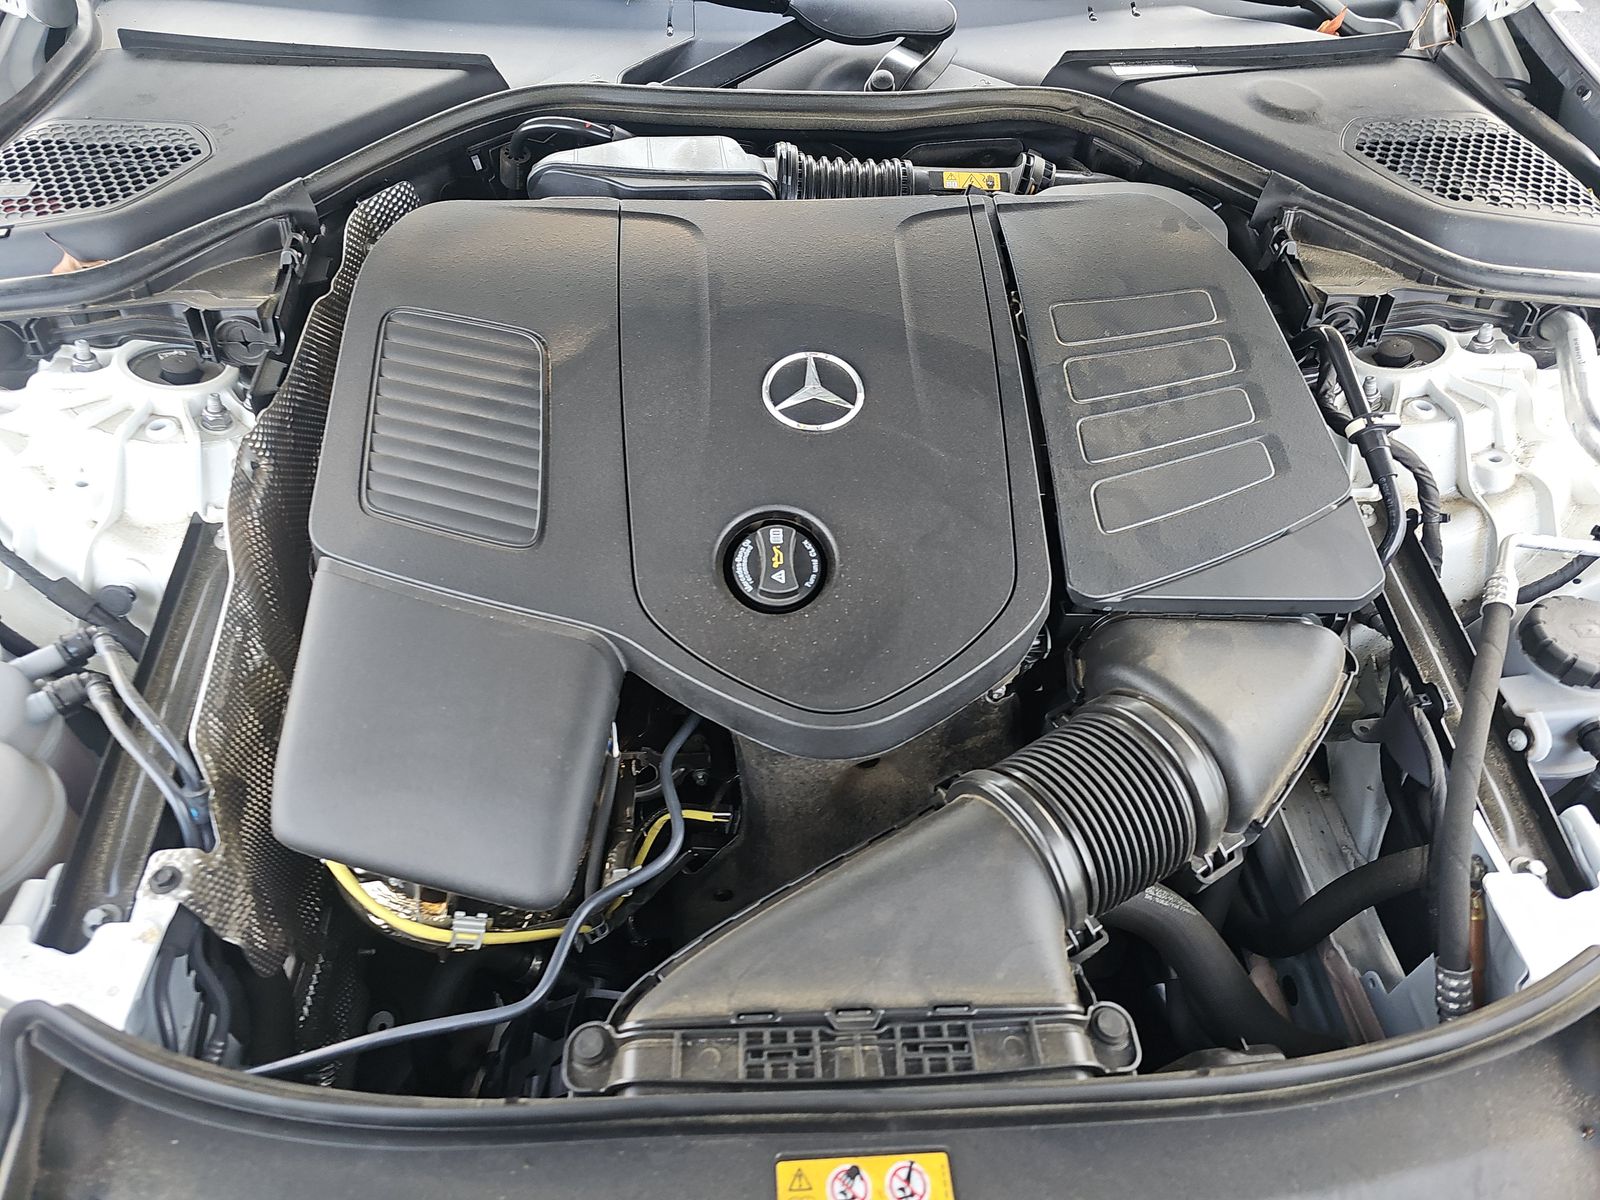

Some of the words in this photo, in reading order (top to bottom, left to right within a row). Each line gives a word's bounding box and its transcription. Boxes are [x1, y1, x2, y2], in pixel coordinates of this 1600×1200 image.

[802, 539, 817, 557] CLICK
[735, 547, 753, 592] Mercedes-Benz
[742, 545, 754, 584] recommended
[804, 574, 817, 587] Turn
